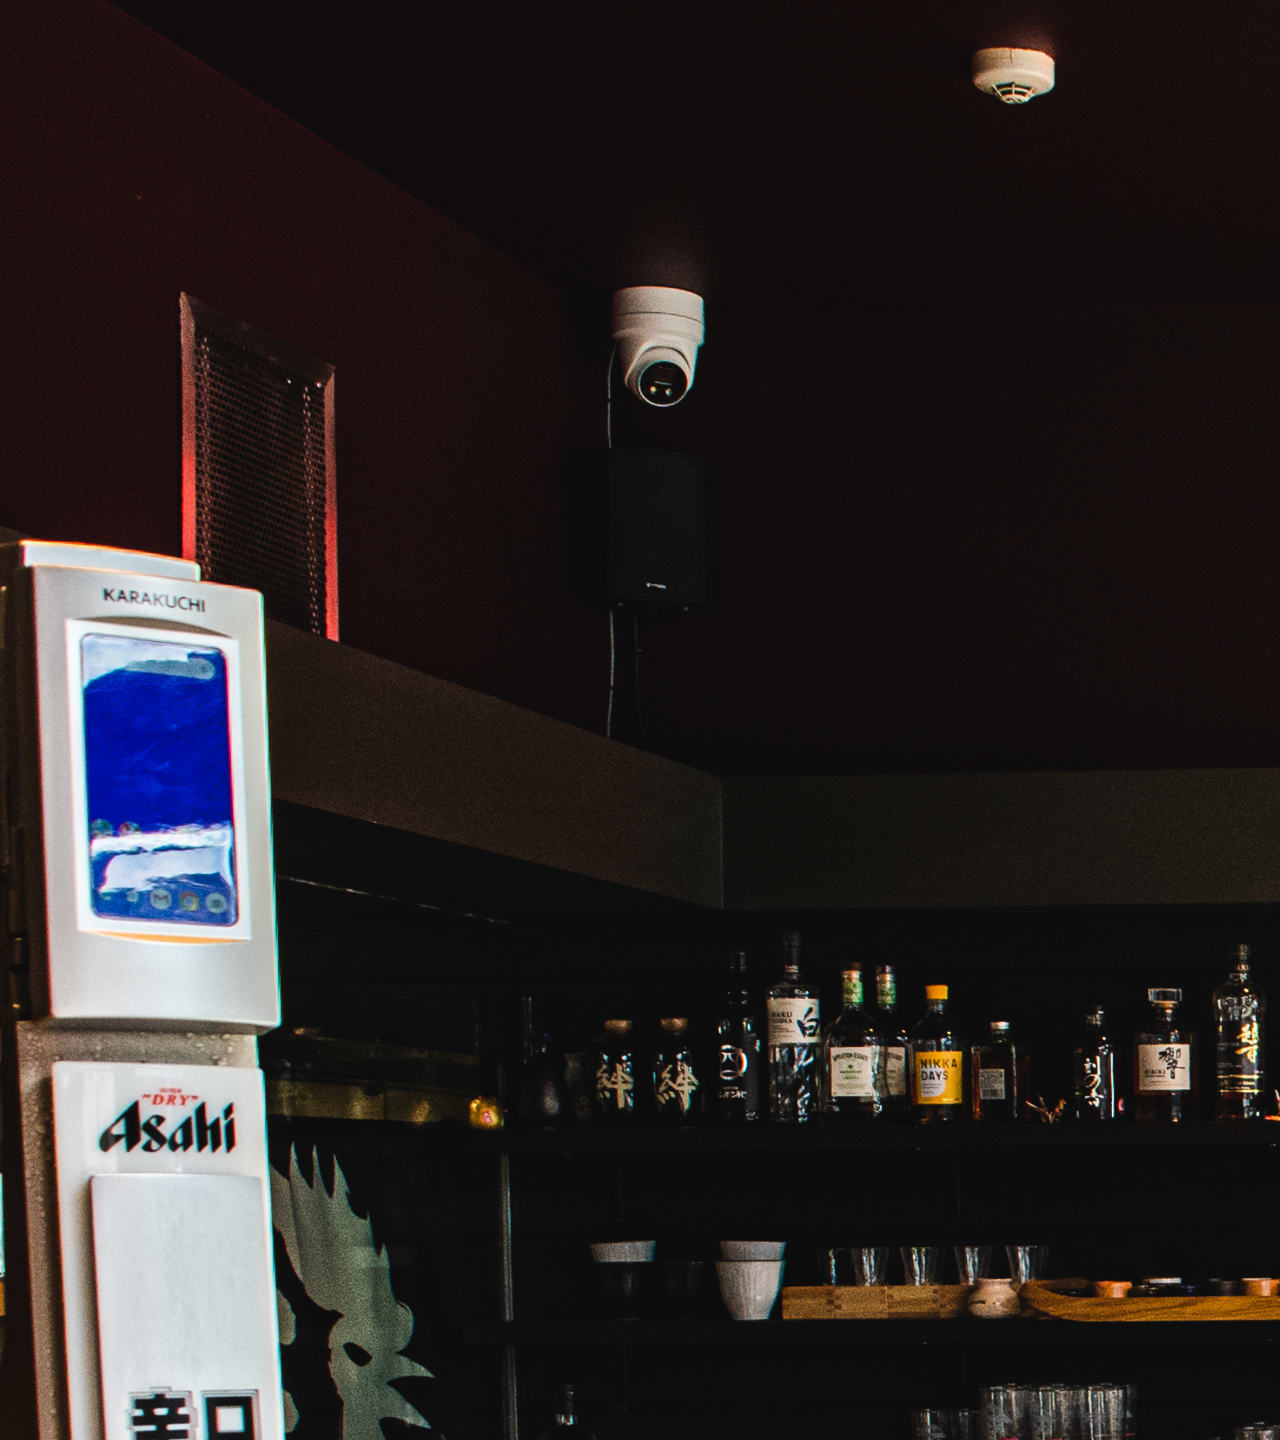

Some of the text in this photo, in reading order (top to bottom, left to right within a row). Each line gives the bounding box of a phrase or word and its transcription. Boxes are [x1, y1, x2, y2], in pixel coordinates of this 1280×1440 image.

[102, 587, 206, 612] KARAKUCHI
[920, 1058, 958, 1069] NIKKA
[920, 1070, 949, 1081] DAYS
[1158, 1047, 1186, 1079] 響
[99, 1100, 237, 1154] Asahi
